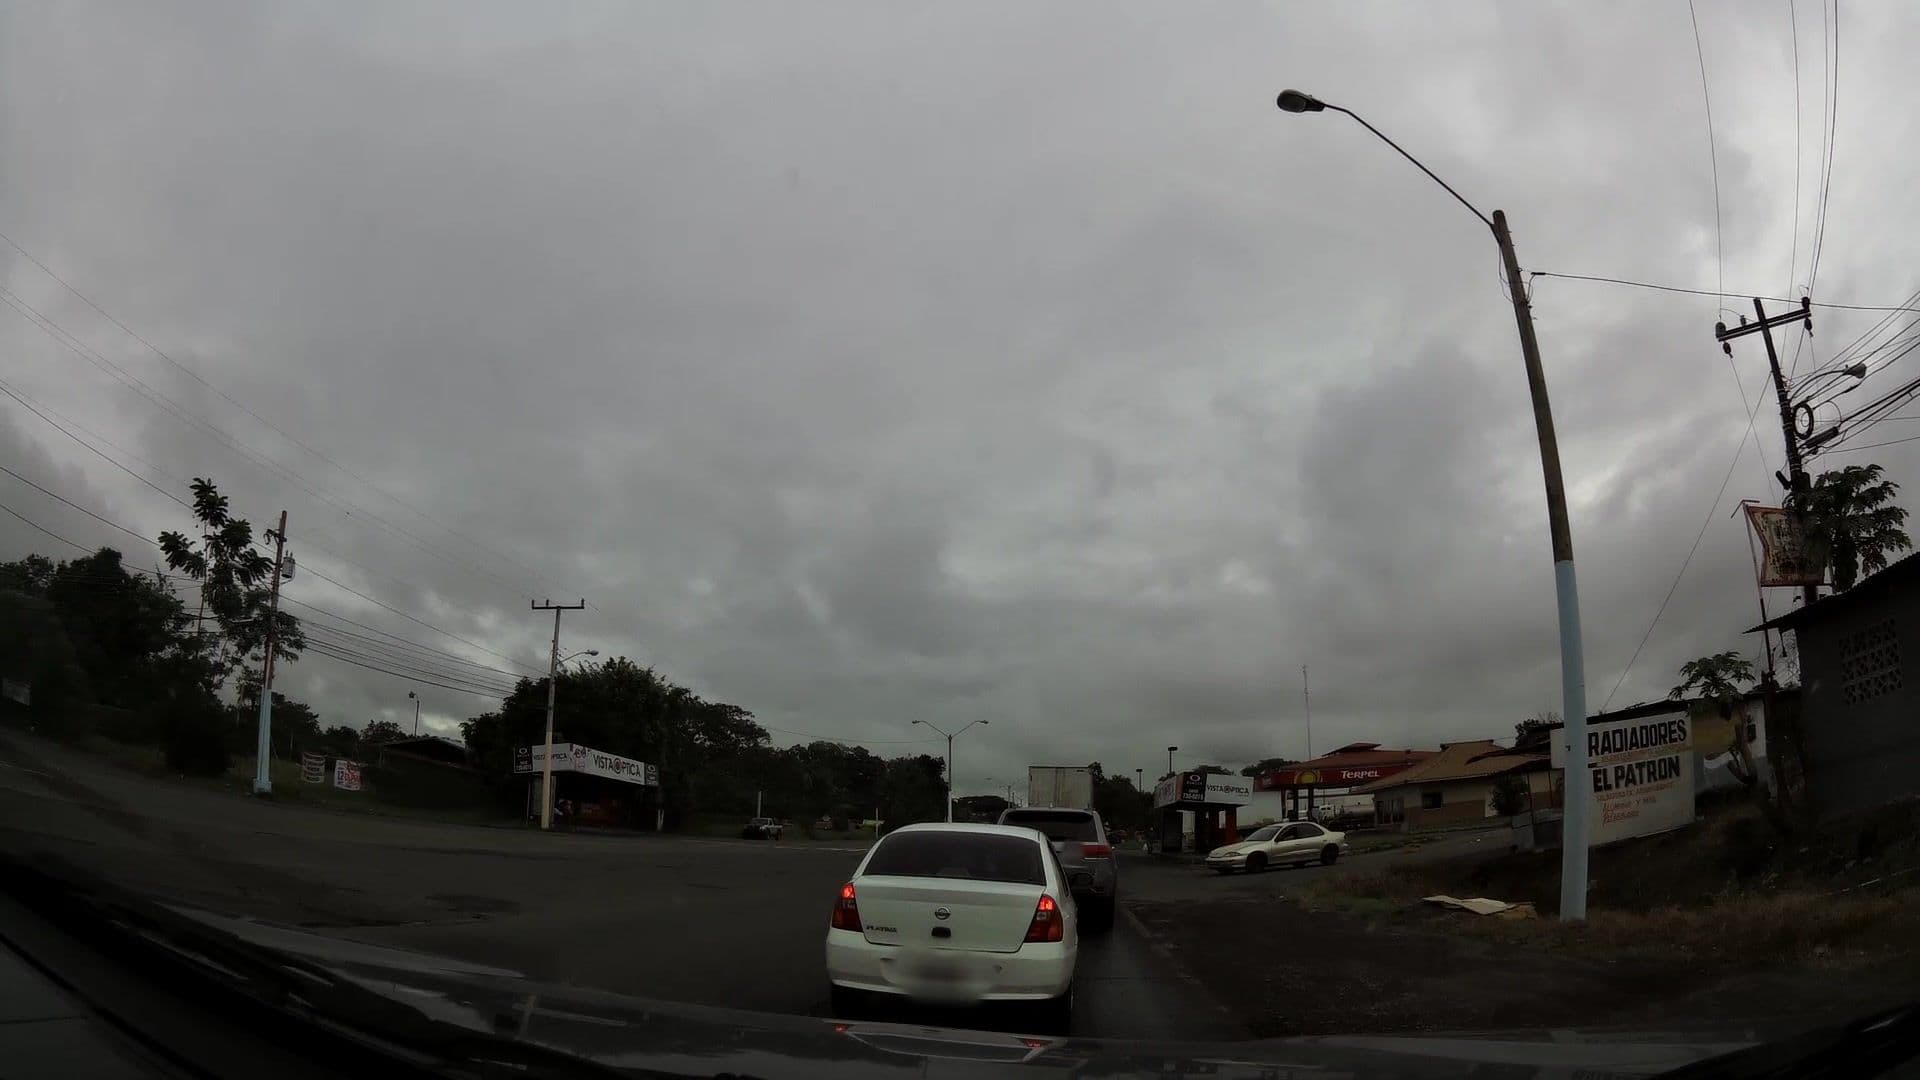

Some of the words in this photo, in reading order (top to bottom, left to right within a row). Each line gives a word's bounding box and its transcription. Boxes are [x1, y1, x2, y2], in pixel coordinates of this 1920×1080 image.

[1588, 719, 1687, 757] RADIADORES
[1593, 767, 1612, 793] EL
[1615, 755, 1681, 789] PATRON
[866, 925, 897, 933] PLATINA
